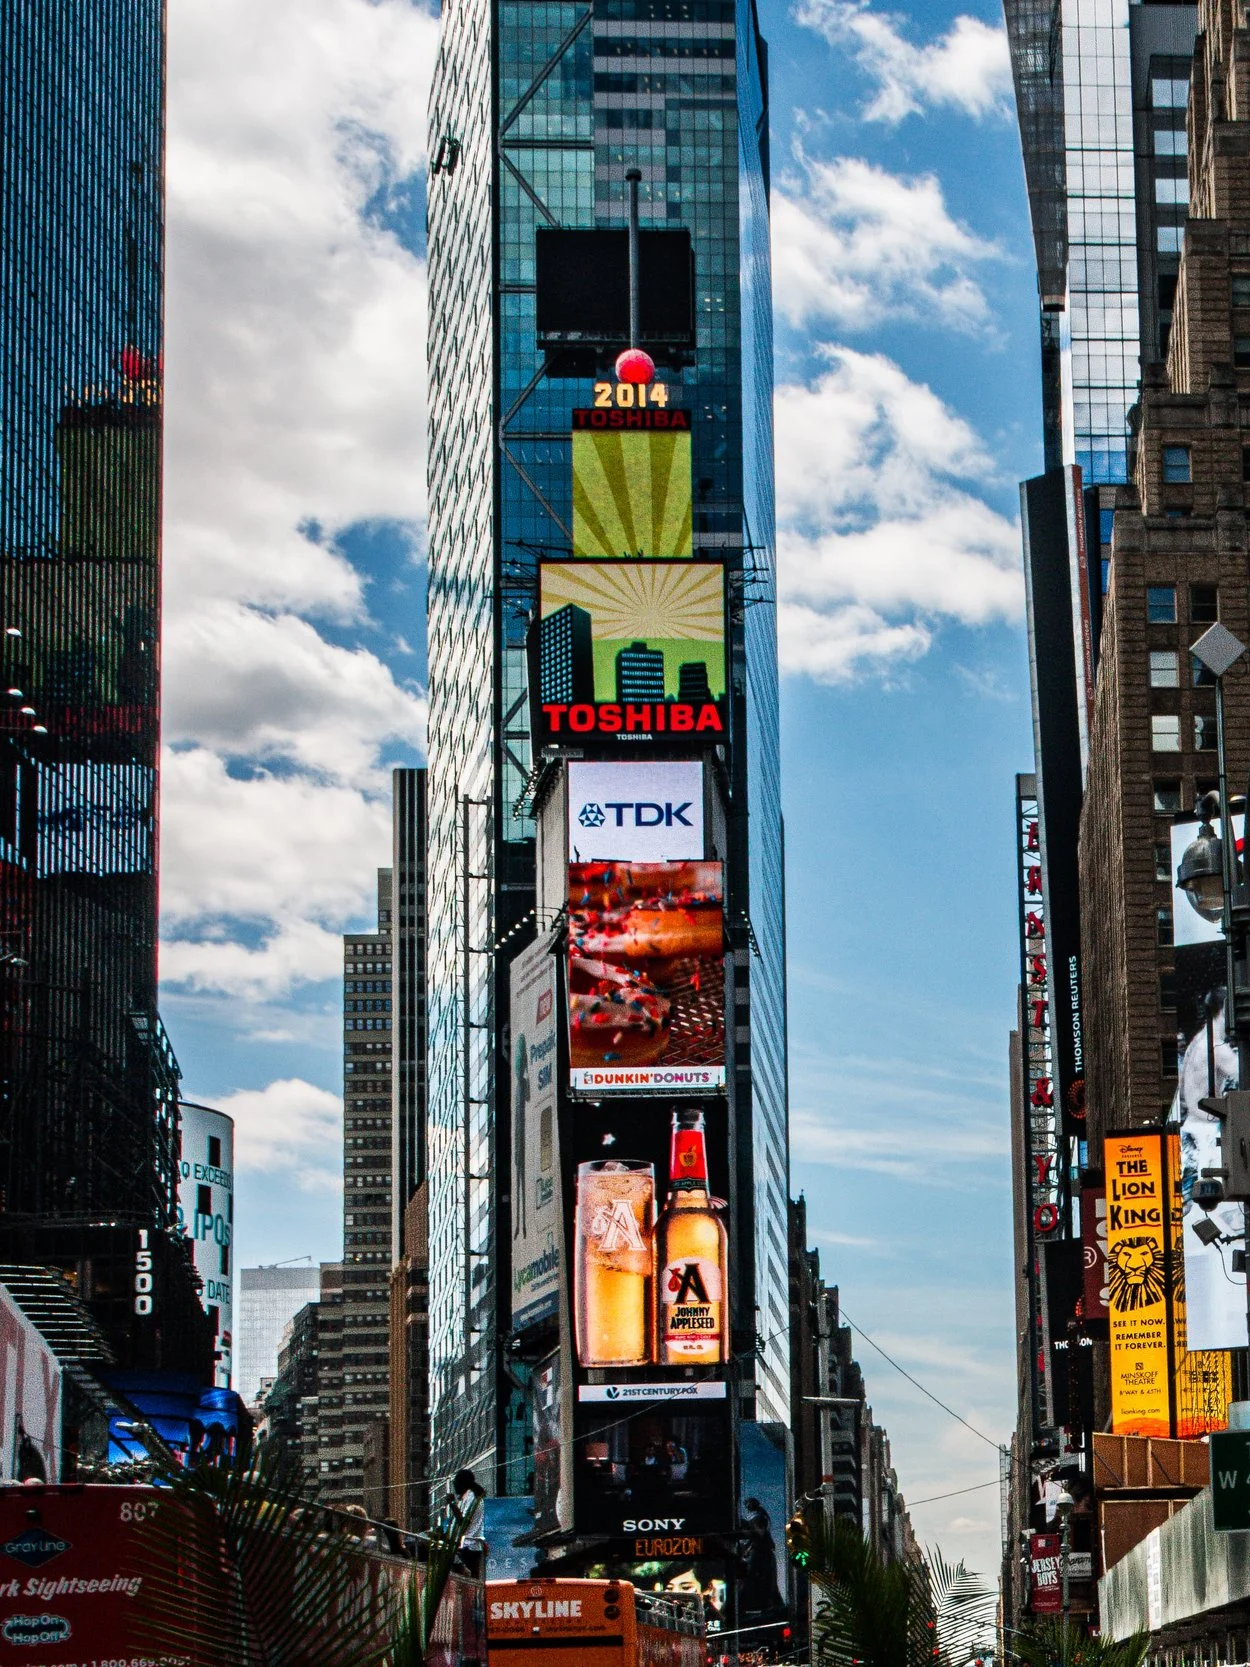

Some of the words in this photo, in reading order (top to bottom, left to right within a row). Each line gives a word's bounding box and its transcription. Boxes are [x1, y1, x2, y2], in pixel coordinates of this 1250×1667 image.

[594, 383, 668, 408] 2014
[574, 409, 688, 429] TOSHIBA
[542, 704, 723, 732] TOSHIBA
[616, 733, 653, 741] TOSHIBA
[605, 802, 694, 827] TDK
[1068, 955, 1080, 1012] REUTERS
[1073, 1014, 1083, 1073] THOMSON
[594, 1071, 654, 1085] DUNKIN'
[654, 1070, 710, 1084] DONUTS
[1118, 1145, 1143, 1154] Disney
[1116, 1159, 1148, 1174] THE
[134, 1228, 153, 1316] 1500
[206, 1279, 230, 1304] DATE
[675, 1306, 711, 1317] JOHNNY
[670, 1316, 715, 1330] APPLESEED
[1113, 1320, 1127, 1328] SEE
[1130, 1319, 1137, 1327] IT
[1140, 1318, 1165, 1326] NOW.
[1116, 1331, 1162, 1340] REMEMBER
[1125, 1341, 1166, 1350] FOREVER.
[1121, 1371, 1158, 1379] MINSKOFF
[1125, 1378, 1155, 1386] THEATRE
[1218, 1471, 1239, 1489] W
[623, 1518, 686, 1532] SONY
[1031, 1555, 1060, 1574] JERSEY
[23, 1574, 143, 1600] Sightseeing
[1037, 1570, 1058, 1587] BOYS
[490, 1600, 583, 1620] SKYLINE
